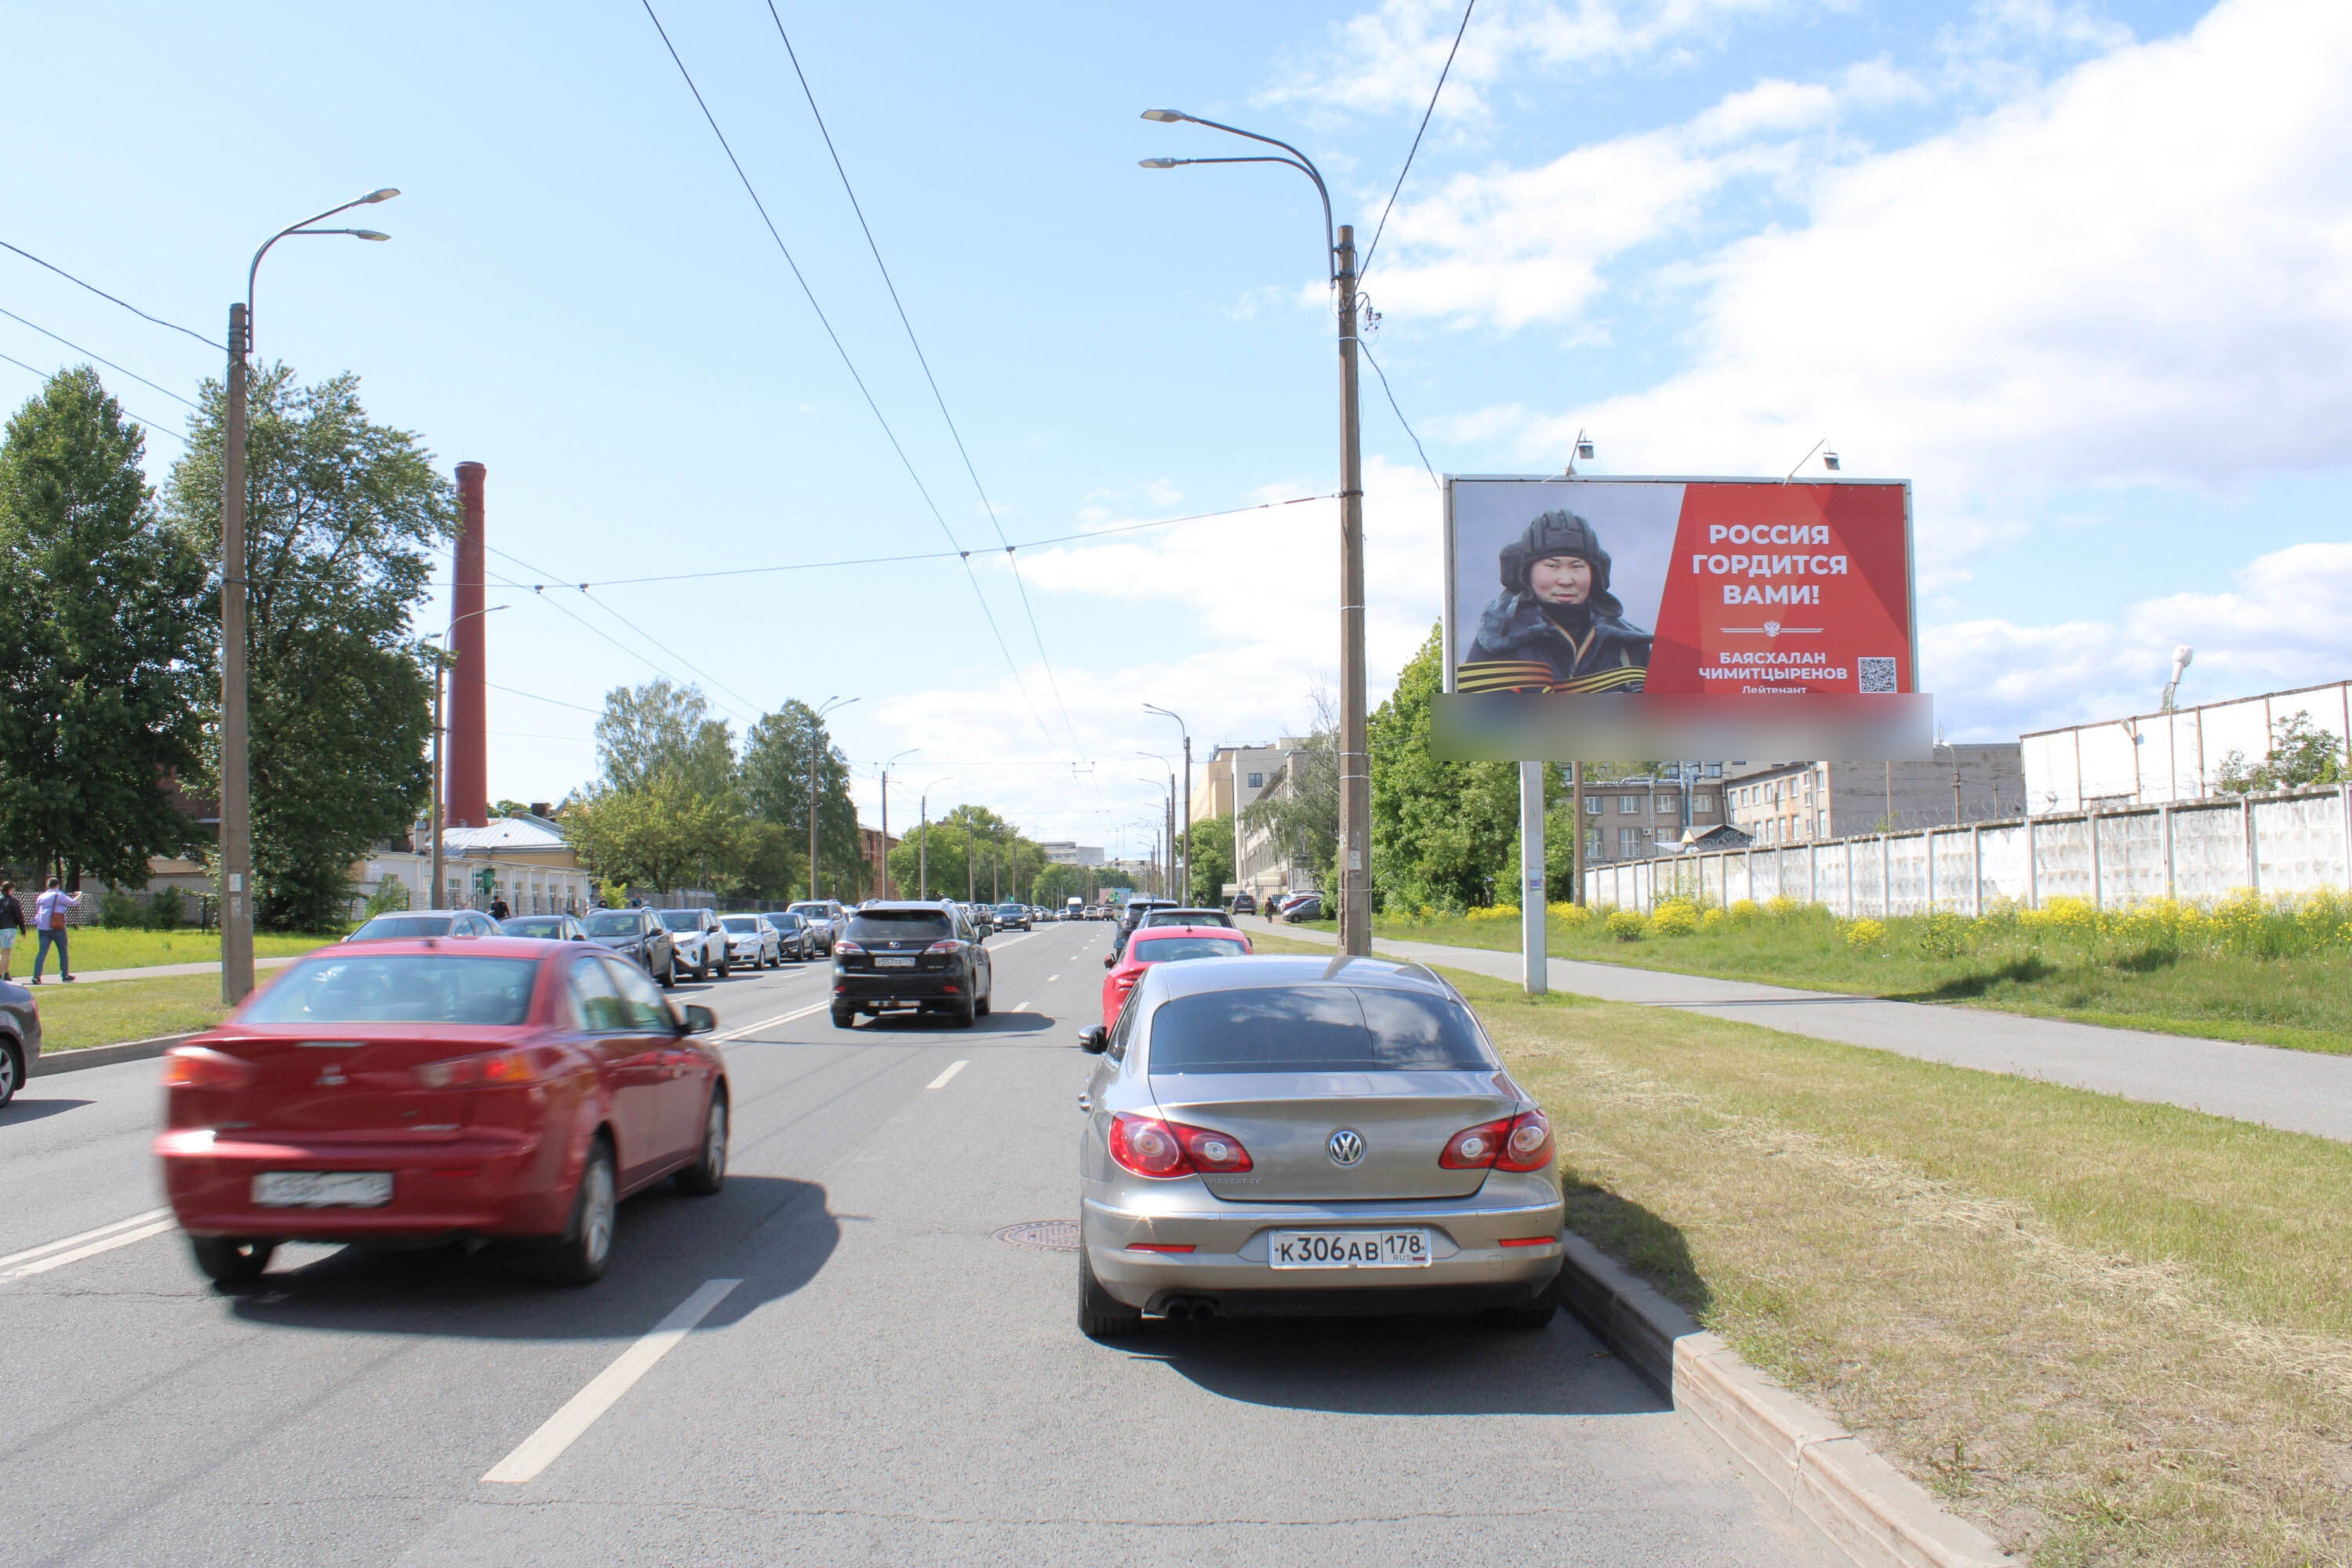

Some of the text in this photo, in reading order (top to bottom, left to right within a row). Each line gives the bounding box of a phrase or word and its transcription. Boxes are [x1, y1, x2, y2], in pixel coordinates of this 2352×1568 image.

[1709, 524, 1829, 545] РОССИЯ
[1693, 554, 1847, 578] ГОРДИТСЯ
[1723, 585, 1820, 604] ВАМИ!
[1719, 652, 1826, 664] БАЯСХАЛАН
[1698, 667, 1847, 681] ЧИМИТЦЫРЕНОВ
[1385, 1235, 1421, 1254] 178
